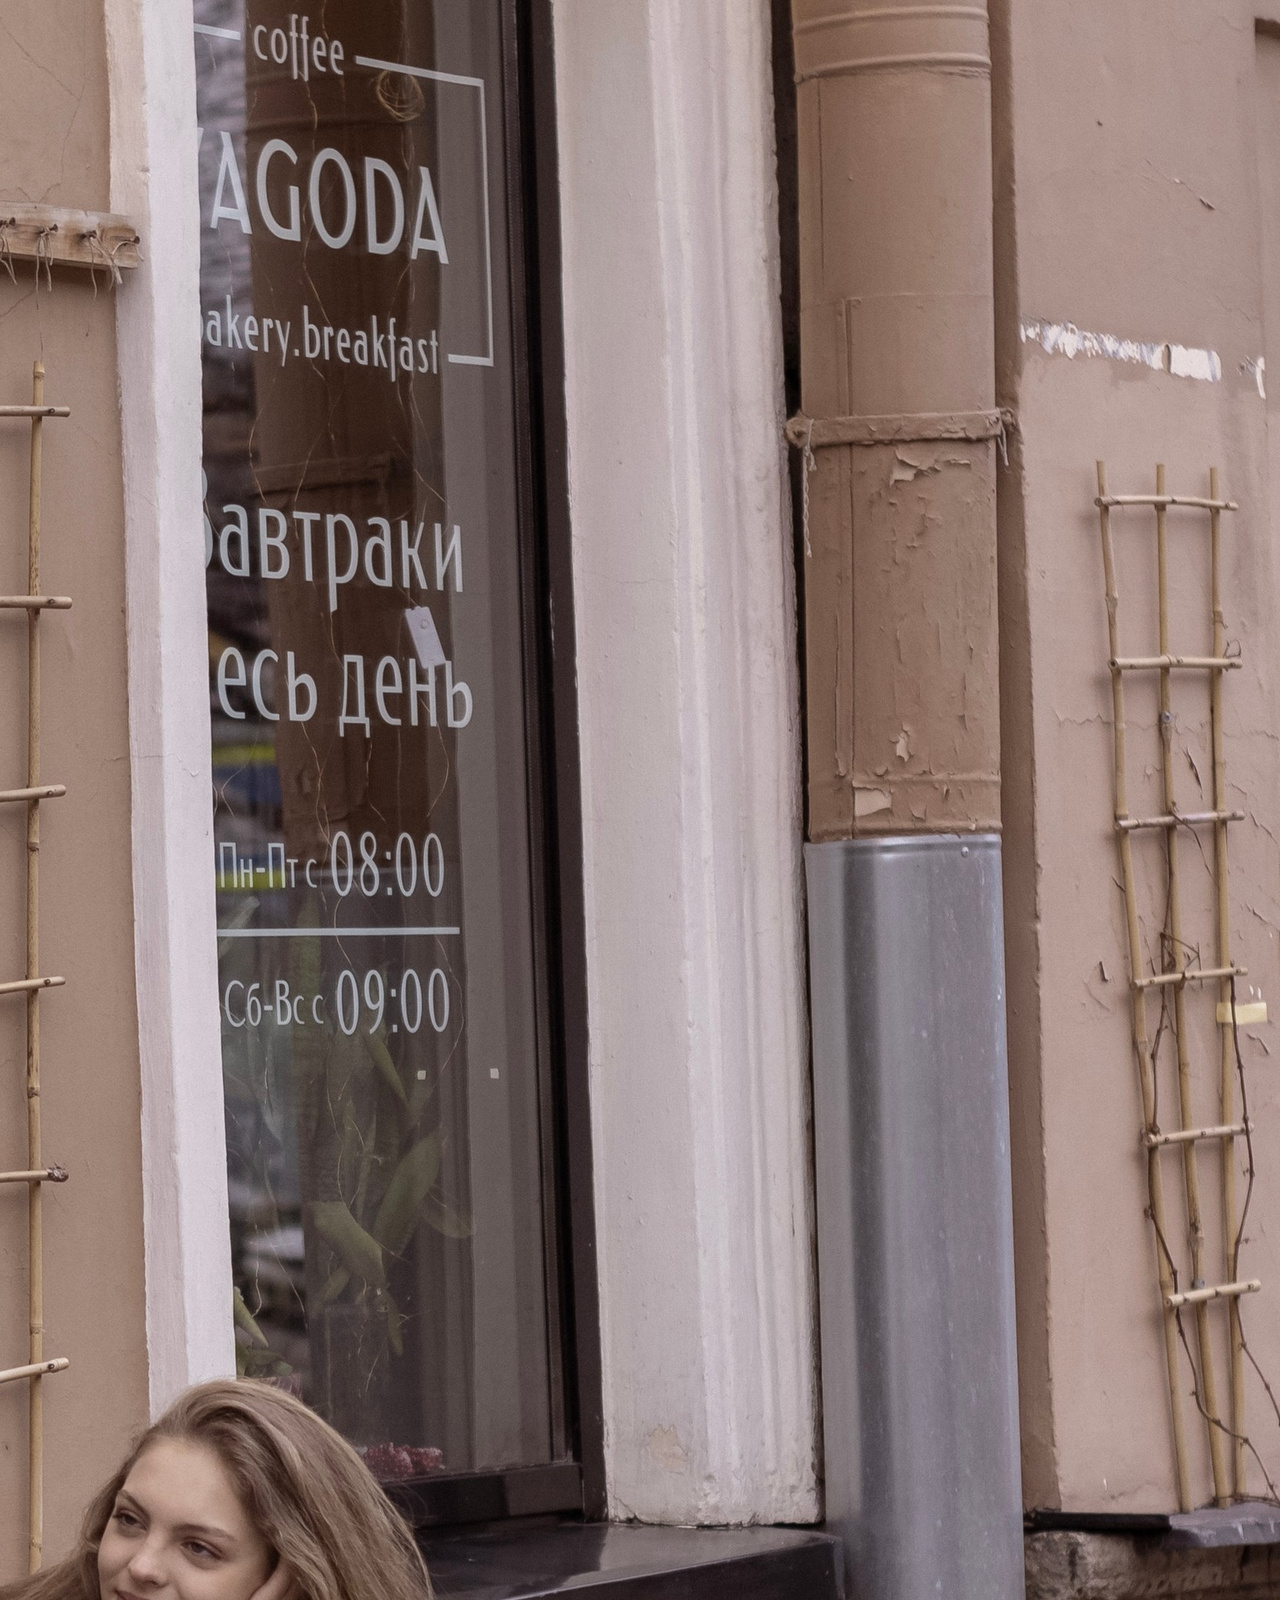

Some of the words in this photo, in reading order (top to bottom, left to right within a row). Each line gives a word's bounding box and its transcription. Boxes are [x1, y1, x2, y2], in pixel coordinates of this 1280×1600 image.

[254, 13, 345, 82] coffee
[197, 126, 450, 265] AGODA
[200, 294, 439, 383] akery.breakfast
[338, 653, 474, 739] день
[219, 841, 299, 889] Пн-Пт
[331, 831, 445, 898] 08:00
[224, 979, 305, 1028] Сб-Вс
[337, 968, 450, 1036] 09:00
